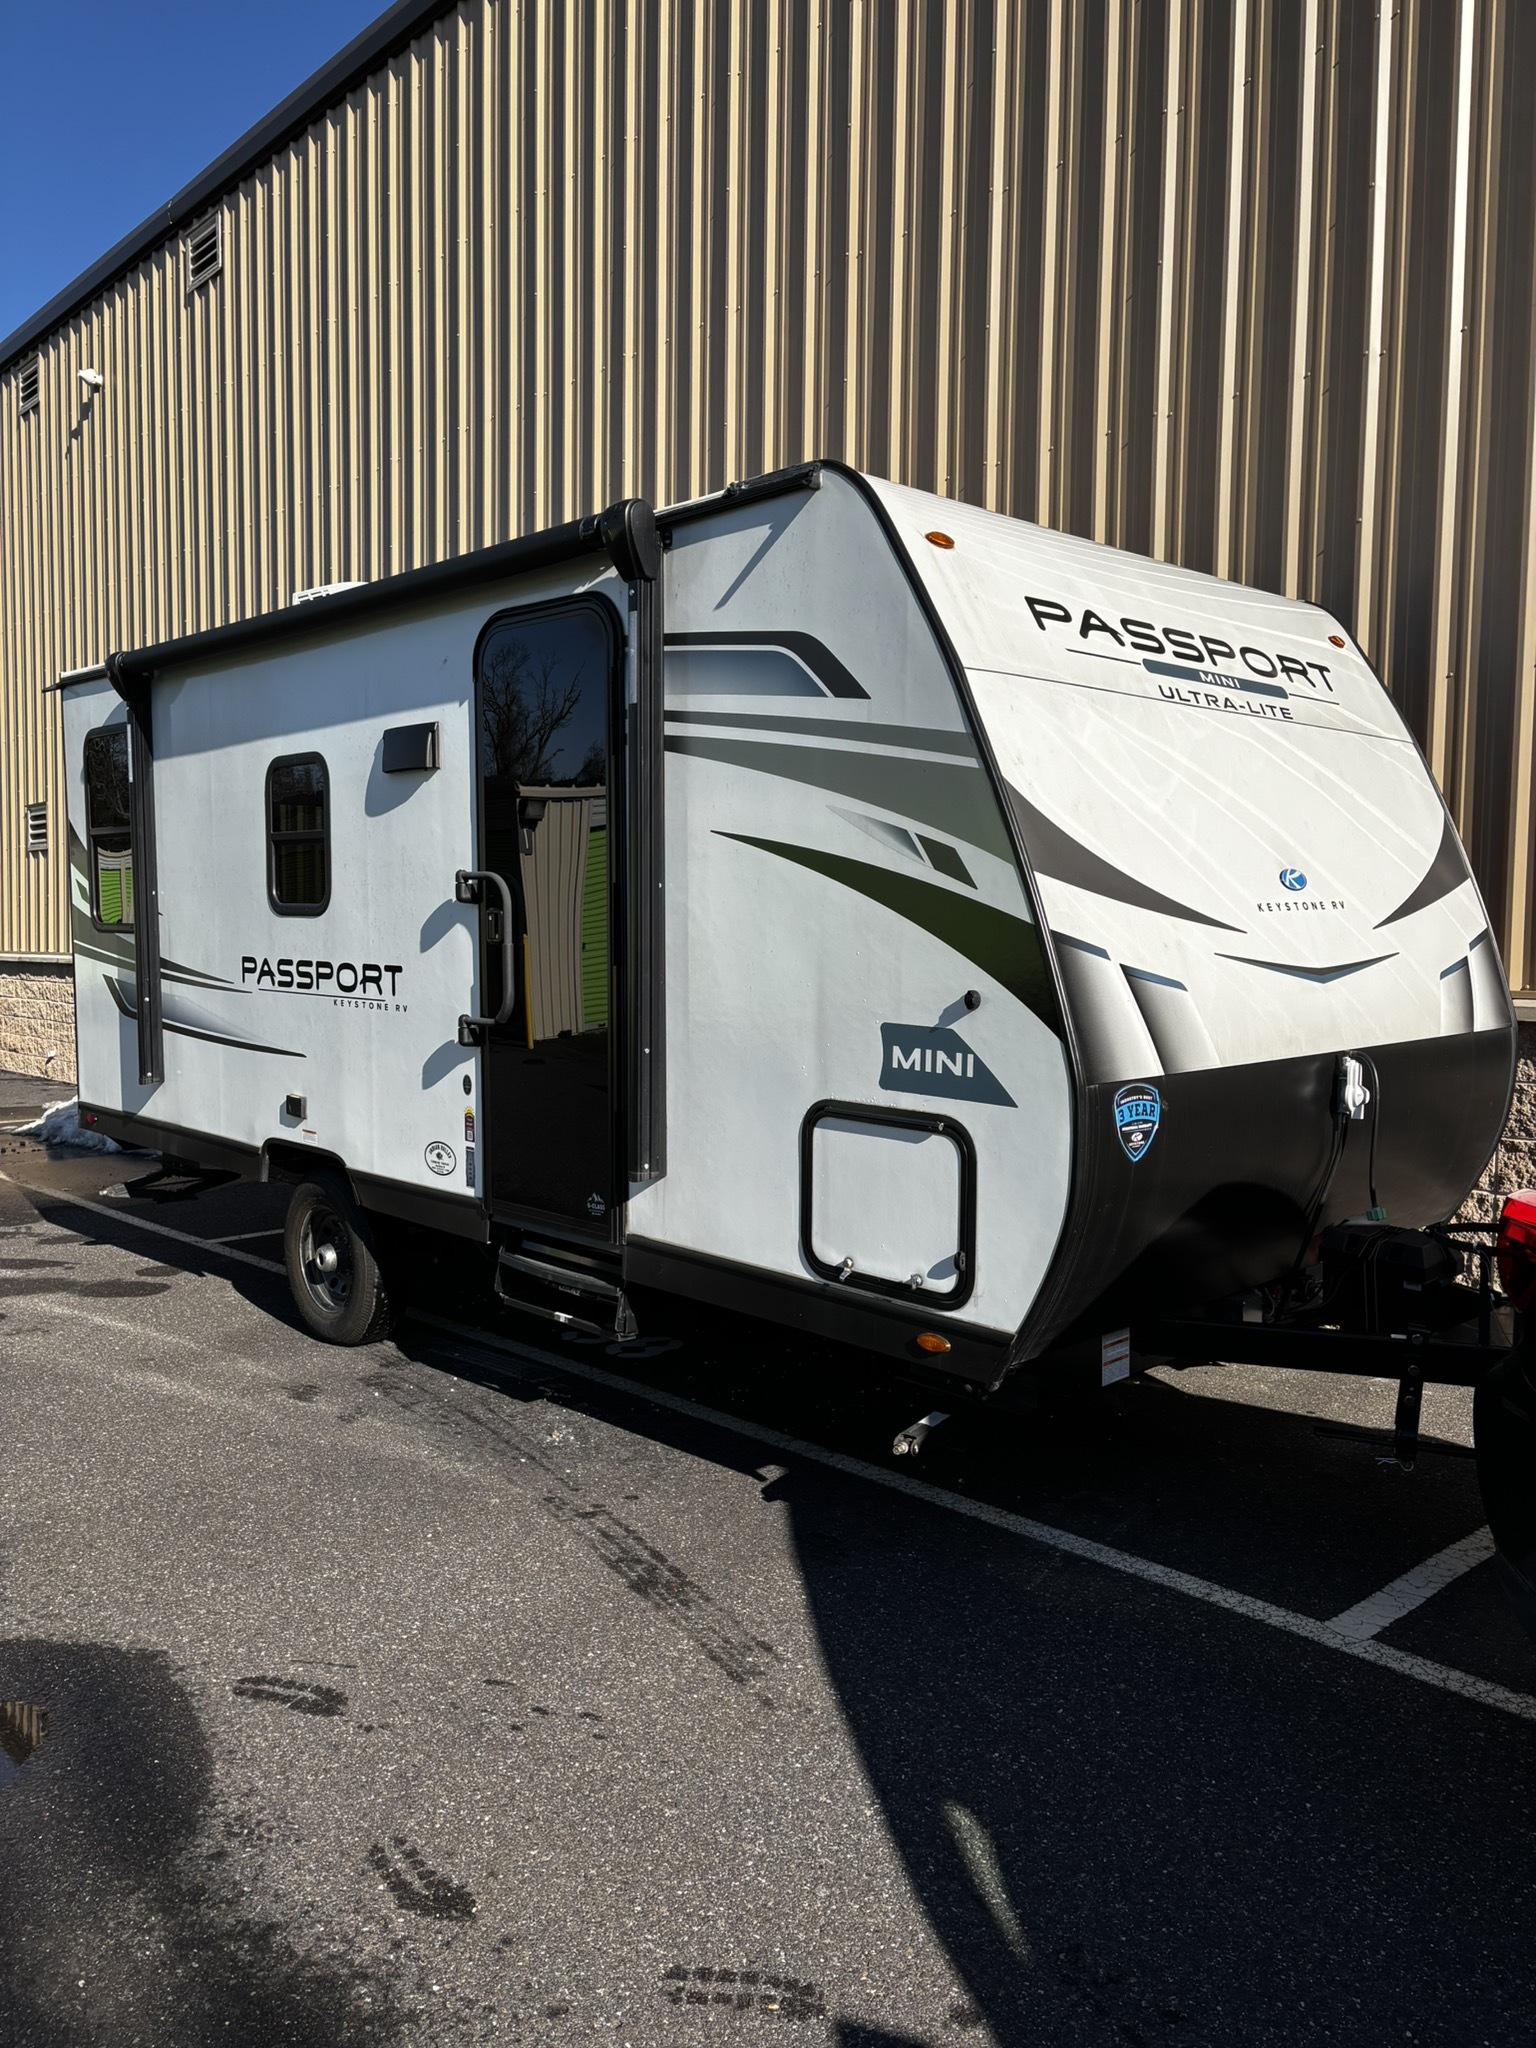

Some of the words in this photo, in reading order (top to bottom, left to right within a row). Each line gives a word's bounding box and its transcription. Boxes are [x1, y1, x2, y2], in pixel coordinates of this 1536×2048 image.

[1024, 596, 1333, 692] PASSPORT
[1199, 671, 1240, 688] MINI
[1158, 685, 1294, 720] ULTRA-LITE
[1256, 901, 1326, 912] KEYSTONE
[1331, 900, 1345, 910] RV
[241, 956, 403, 997] PASSPORT
[333, 999, 389, 1011] KEYSTONE
[395, 1004, 408, 1012] RV
[891, 1045, 975, 1078] MINI
[1118, 1109, 1125, 1123] 3
[1127, 1103, 1155, 1118] YEAR
